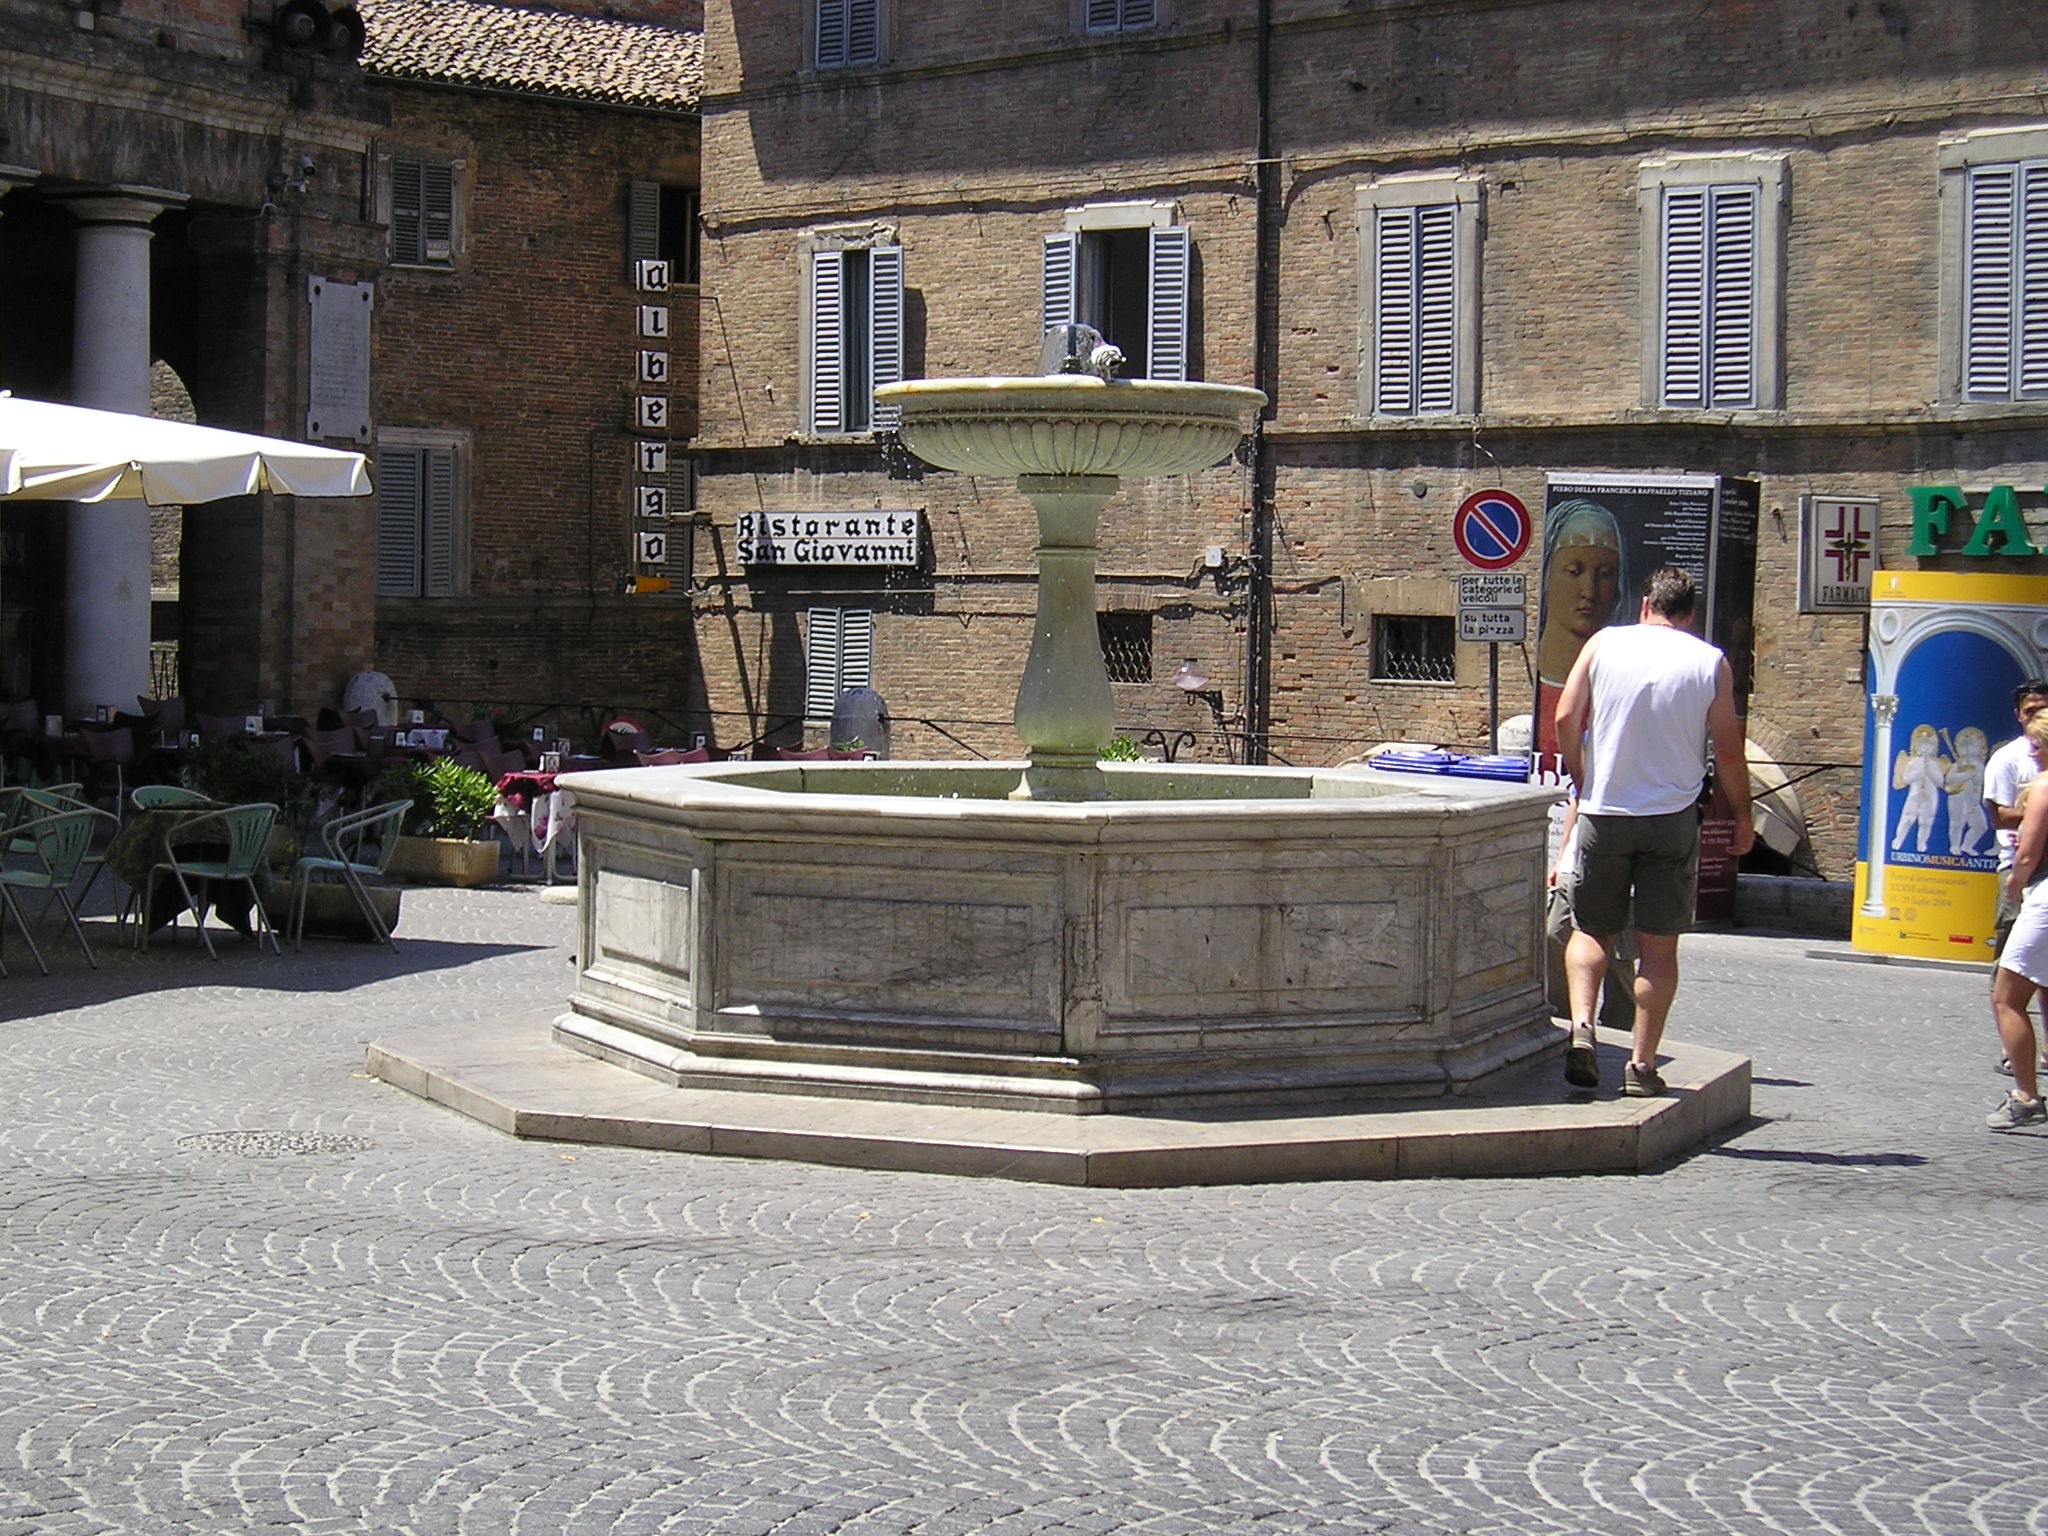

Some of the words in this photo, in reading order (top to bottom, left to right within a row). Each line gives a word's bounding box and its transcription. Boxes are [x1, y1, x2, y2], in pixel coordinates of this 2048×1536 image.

[1552, 485, 1574, 493] PIERO
[1574, 486, 1596, 494] DELLA
[1597, 487, 1637, 495] FRANCESCA
[1638, 488, 1677, 496] RAFFAELLO
[1678, 489, 1709, 497] TIZIANO
[738, 511, 915, 537] Ristorante
[1904, 485, 2048, 556] FA
[738, 539, 786, 562] San
[794, 538, 914, 562] Giovanni
[1462, 577, 1479, 586] per
[1483, 576, 1510, 585] tutte
[1512, 575, 1522, 585] le
[1462, 585, 1512, 595] categorie
[1462, 593, 1498, 603] veicoli
[1464, 614, 1477, 622] su
[1482, 613, 1511, 622] tutta
[1464, 625, 1475, 634] la
